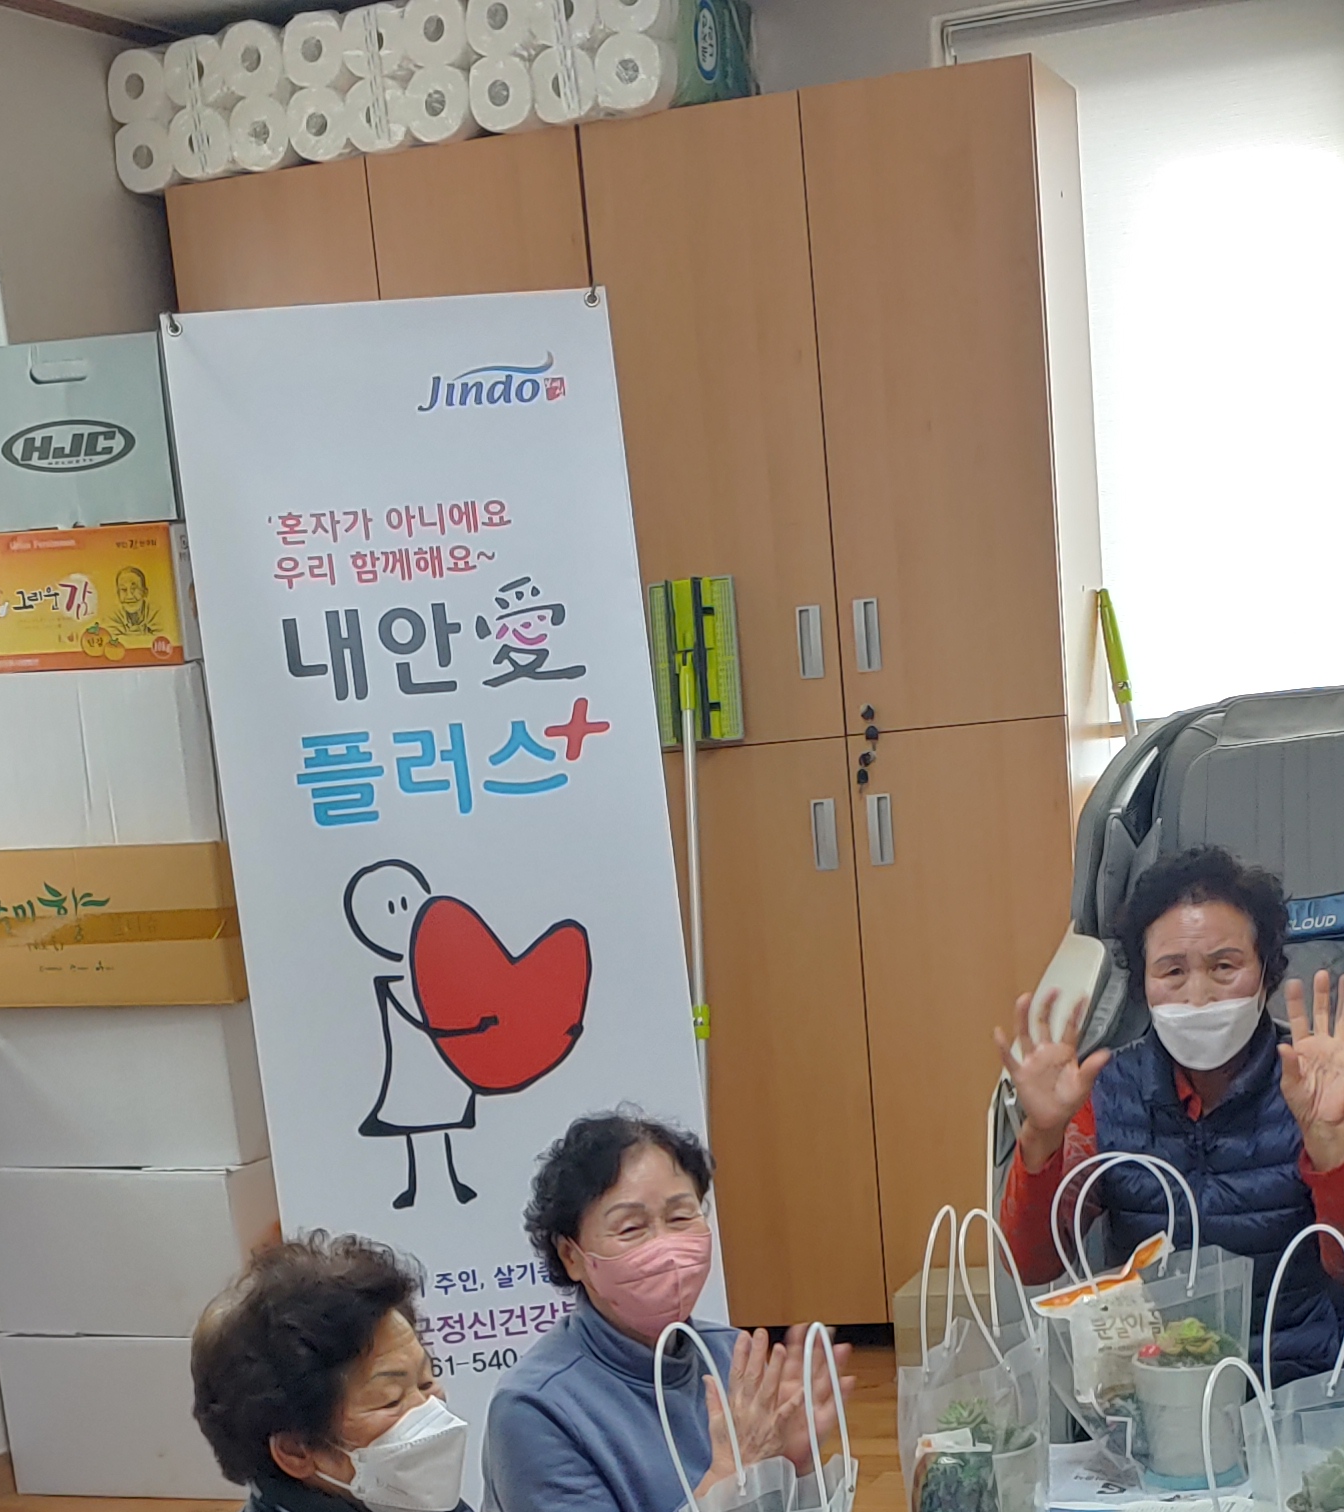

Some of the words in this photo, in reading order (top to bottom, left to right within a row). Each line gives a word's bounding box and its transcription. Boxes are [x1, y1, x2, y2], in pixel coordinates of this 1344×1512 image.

[417, 370, 541, 413] Jindo
[21, 430, 116, 462] HJC
[385, 499, 513, 538] 아니에요
[273, 553, 337, 590] 우리
[434, 1269, 484, 1296] 주인,
